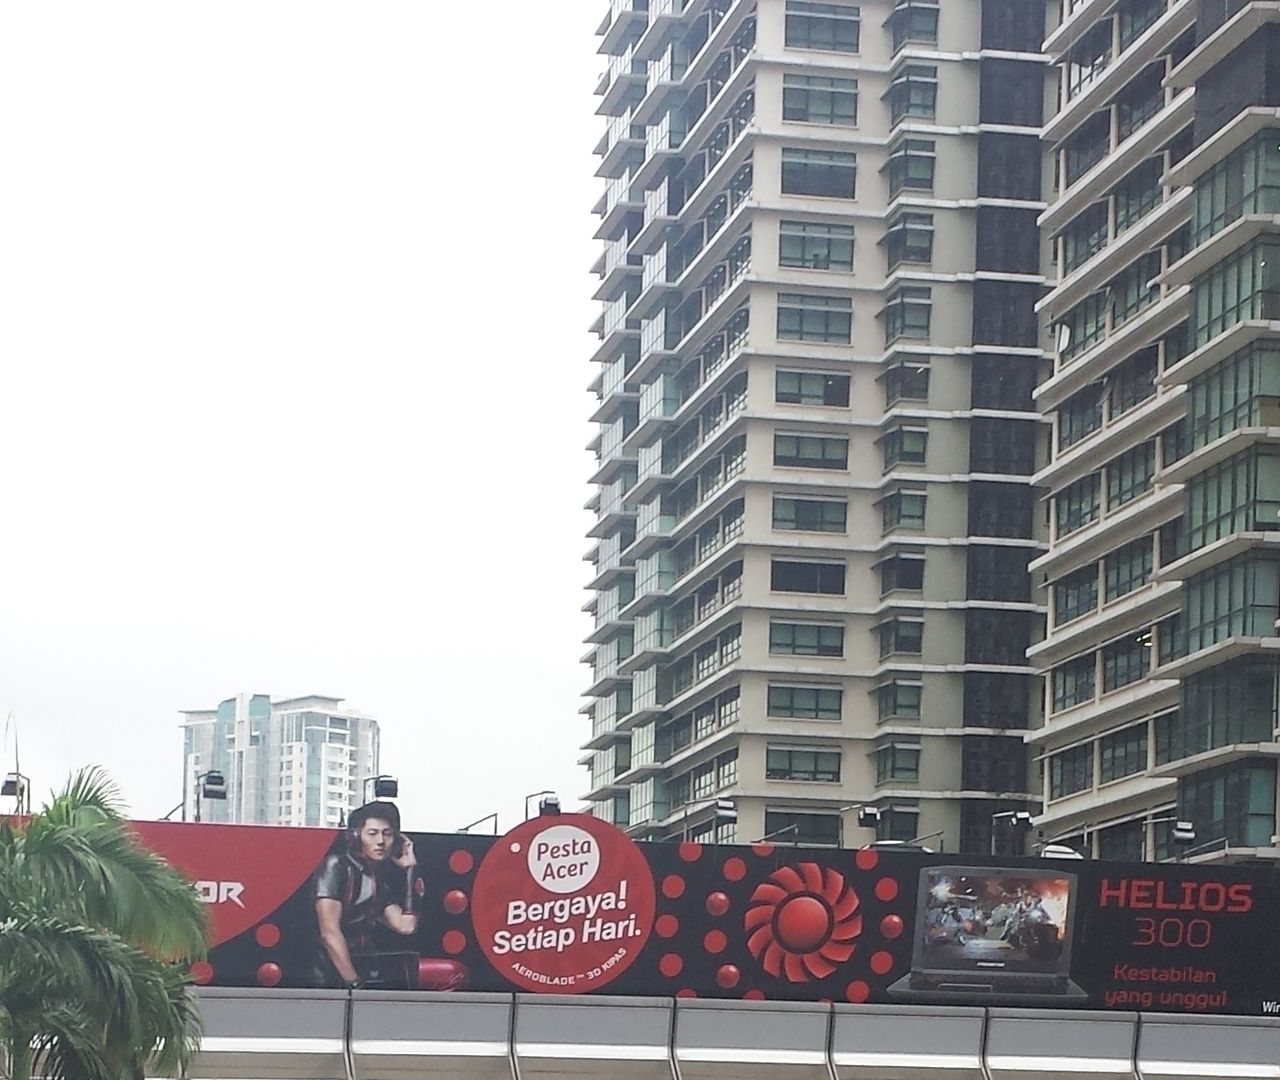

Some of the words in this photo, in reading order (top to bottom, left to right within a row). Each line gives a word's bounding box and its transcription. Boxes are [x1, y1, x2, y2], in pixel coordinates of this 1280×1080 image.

[537, 838, 591, 861] Pesta
[542, 861, 588, 881] Acer
[507, 880, 627, 925] Bergaya!
[1100, 879, 1253, 912] HELIOS
[493, 925, 576, 955] Setiap
[582, 914, 641, 943] Hari.
[1132, 917, 1211, 947] 300
[586, 967, 602, 980] 3D
[602, 947, 627, 972] KIPAS
[1113, 964, 1217, 983] Kestabilan
[1104, 989, 1153, 1007] yang
[1160, 990, 1228, 1008] unggul
